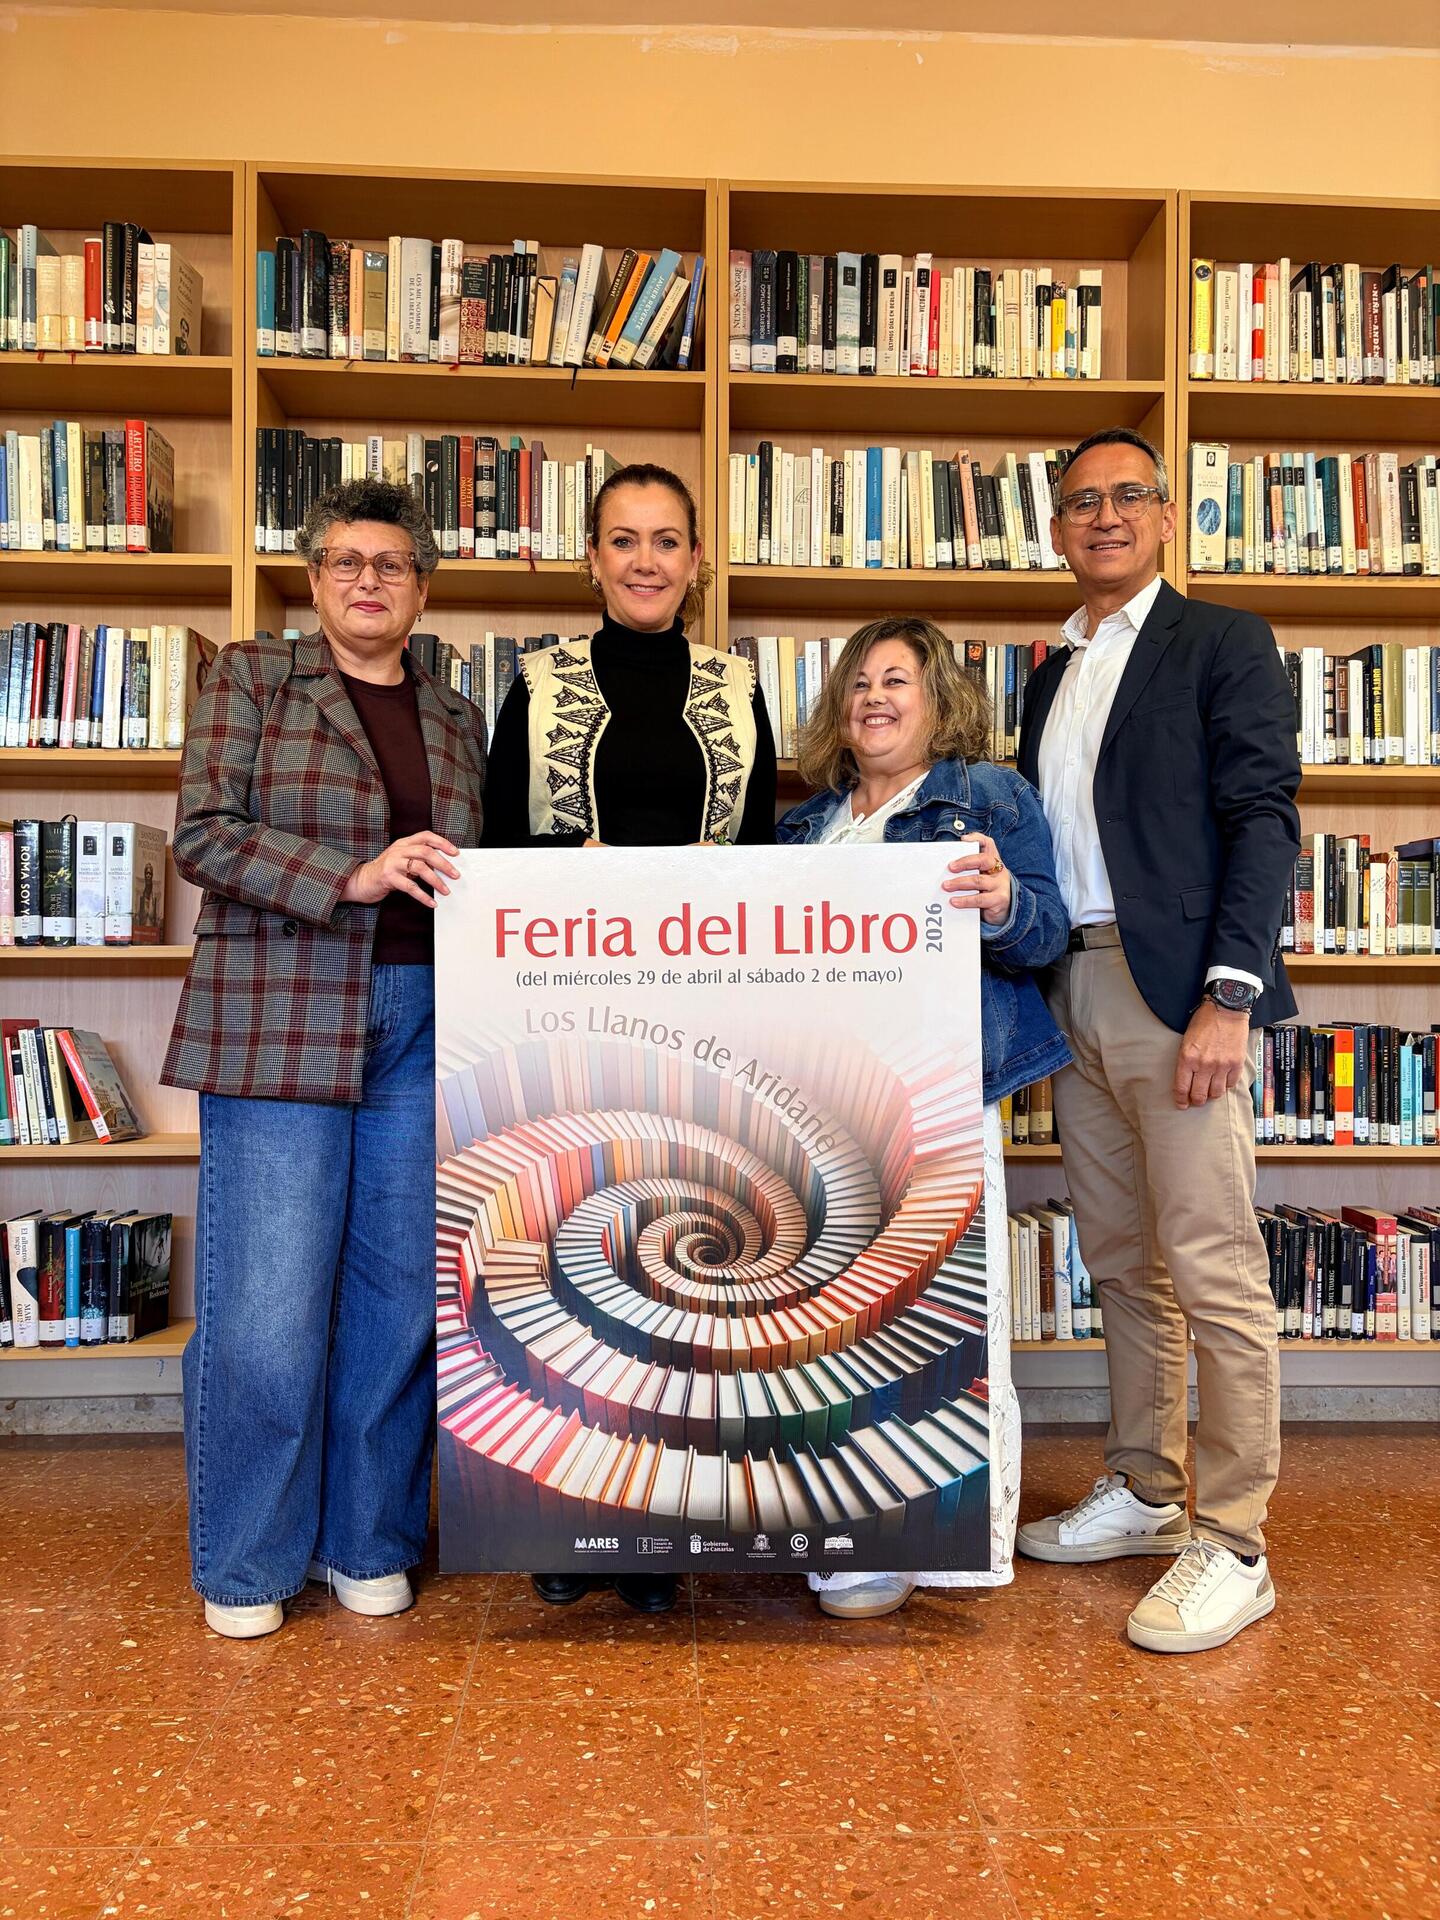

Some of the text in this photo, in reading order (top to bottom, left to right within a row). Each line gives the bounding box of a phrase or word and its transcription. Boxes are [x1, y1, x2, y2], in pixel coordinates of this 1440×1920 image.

[408, 277, 415, 287] DE
[611, 254, 630, 297] JAVIER REVERTE
[734, 268, 743, 298] SANGRE
[408, 288, 415, 297] LA
[635, 276, 665, 330] JAVIER REVERTE
[1372, 290, 1380, 314] NIÑA
[1372, 324, 1380, 358] ANDÉN
[133, 430, 143, 472] ARTURO
[1372, 668, 1381, 696] PÁJARO
[21, 846, 31, 880] ROMA
[21, 884, 31, 906] SOY
[495, 900, 919, 958] Feria del Libro
[924, 902, 944, 953] 2026
[515, 966, 904, 988] (del miércoles 29 de abril al sábado 2 de mayo)
[525, 1005, 837, 1155] Los Llanos de Aridane
[21, 1236, 29, 1263] albatros
[574, 1538, 619, 1549] MARES
